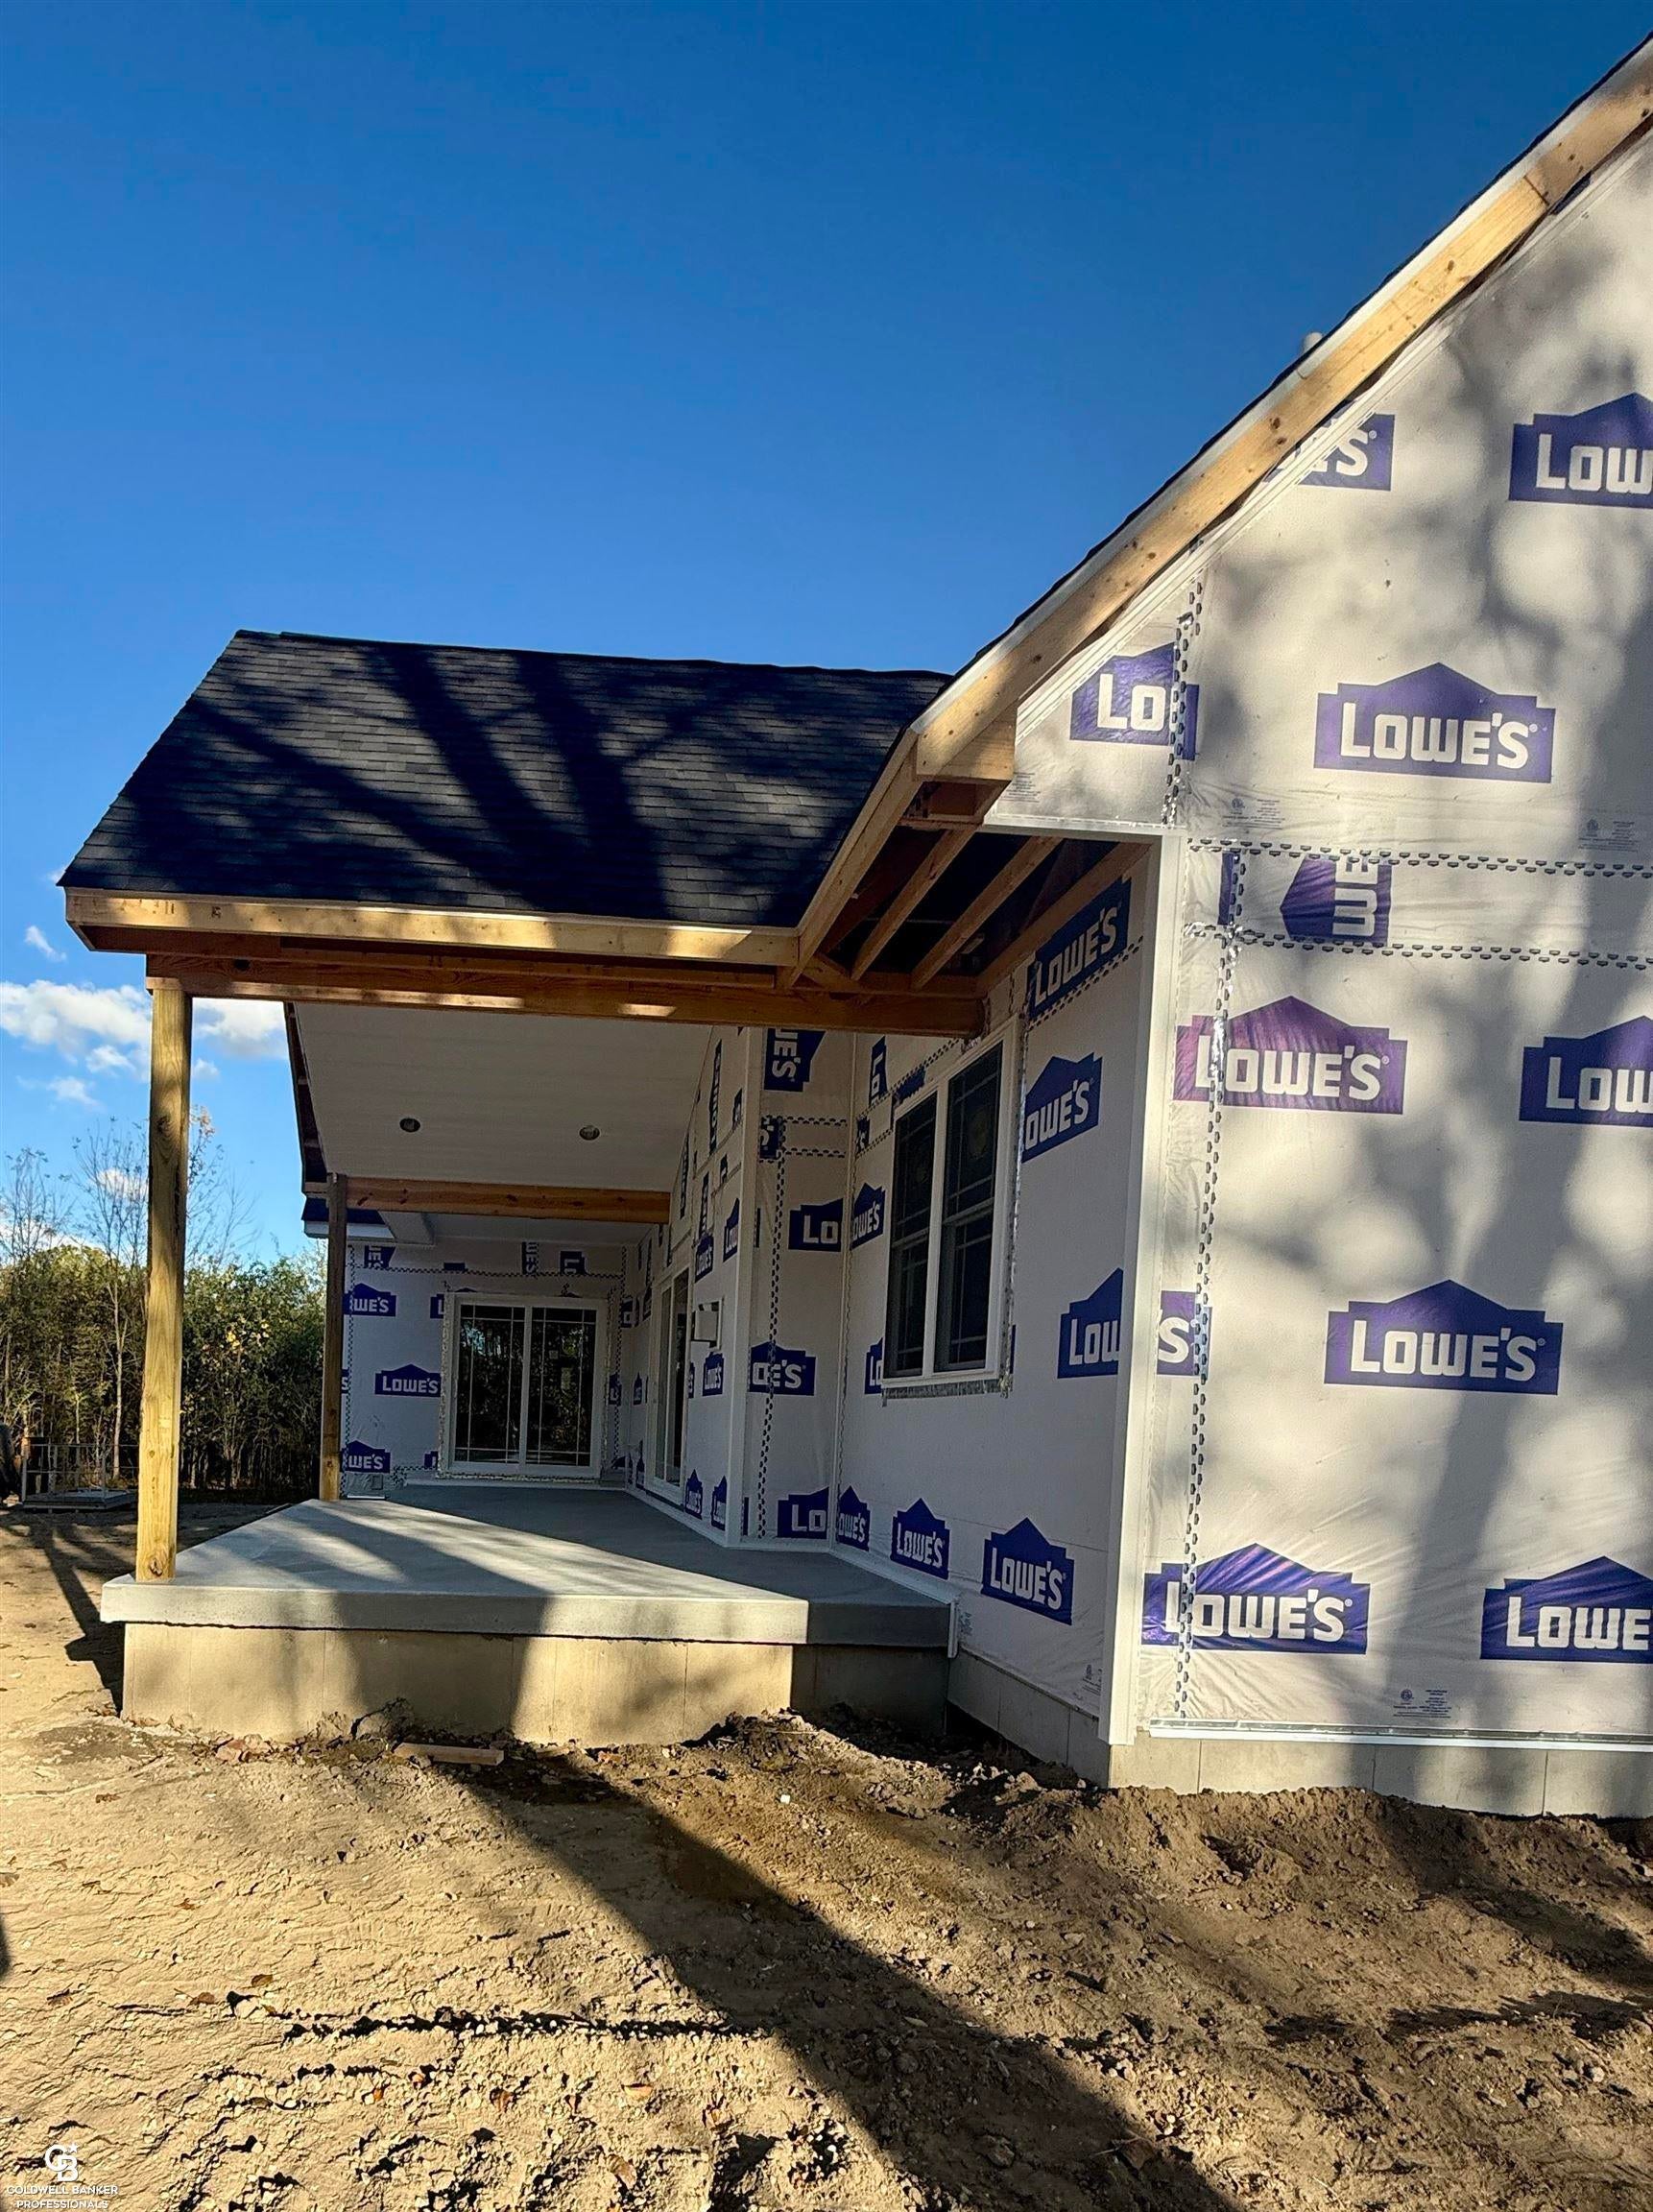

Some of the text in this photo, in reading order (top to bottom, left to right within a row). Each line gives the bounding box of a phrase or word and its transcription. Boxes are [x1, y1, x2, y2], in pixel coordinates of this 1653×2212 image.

[1536, 433, 1652, 495] LOW
[1097, 673, 1166, 732] LO
[1340, 702, 1530, 769] LOWE'S
[1035, 906, 1118, 1008] LOWE'S
[1025, 1079, 1090, 1151] OWE'S
[1546, 1056, 1653, 1115] LOW
[803, 1214, 839, 1244] LO
[1159, 1316, 1189, 1363] S
[1351, 1319, 1537, 1382] LOWE'S
[382, 1375, 440, 1395] LOWE'S
[791, 1503, 827, 1533] LO
[897, 1523, 944, 1568] LOWE'S
[990, 1547, 1064, 1610] LOWE'S
[1507, 1596, 1652, 1651] LOWE
